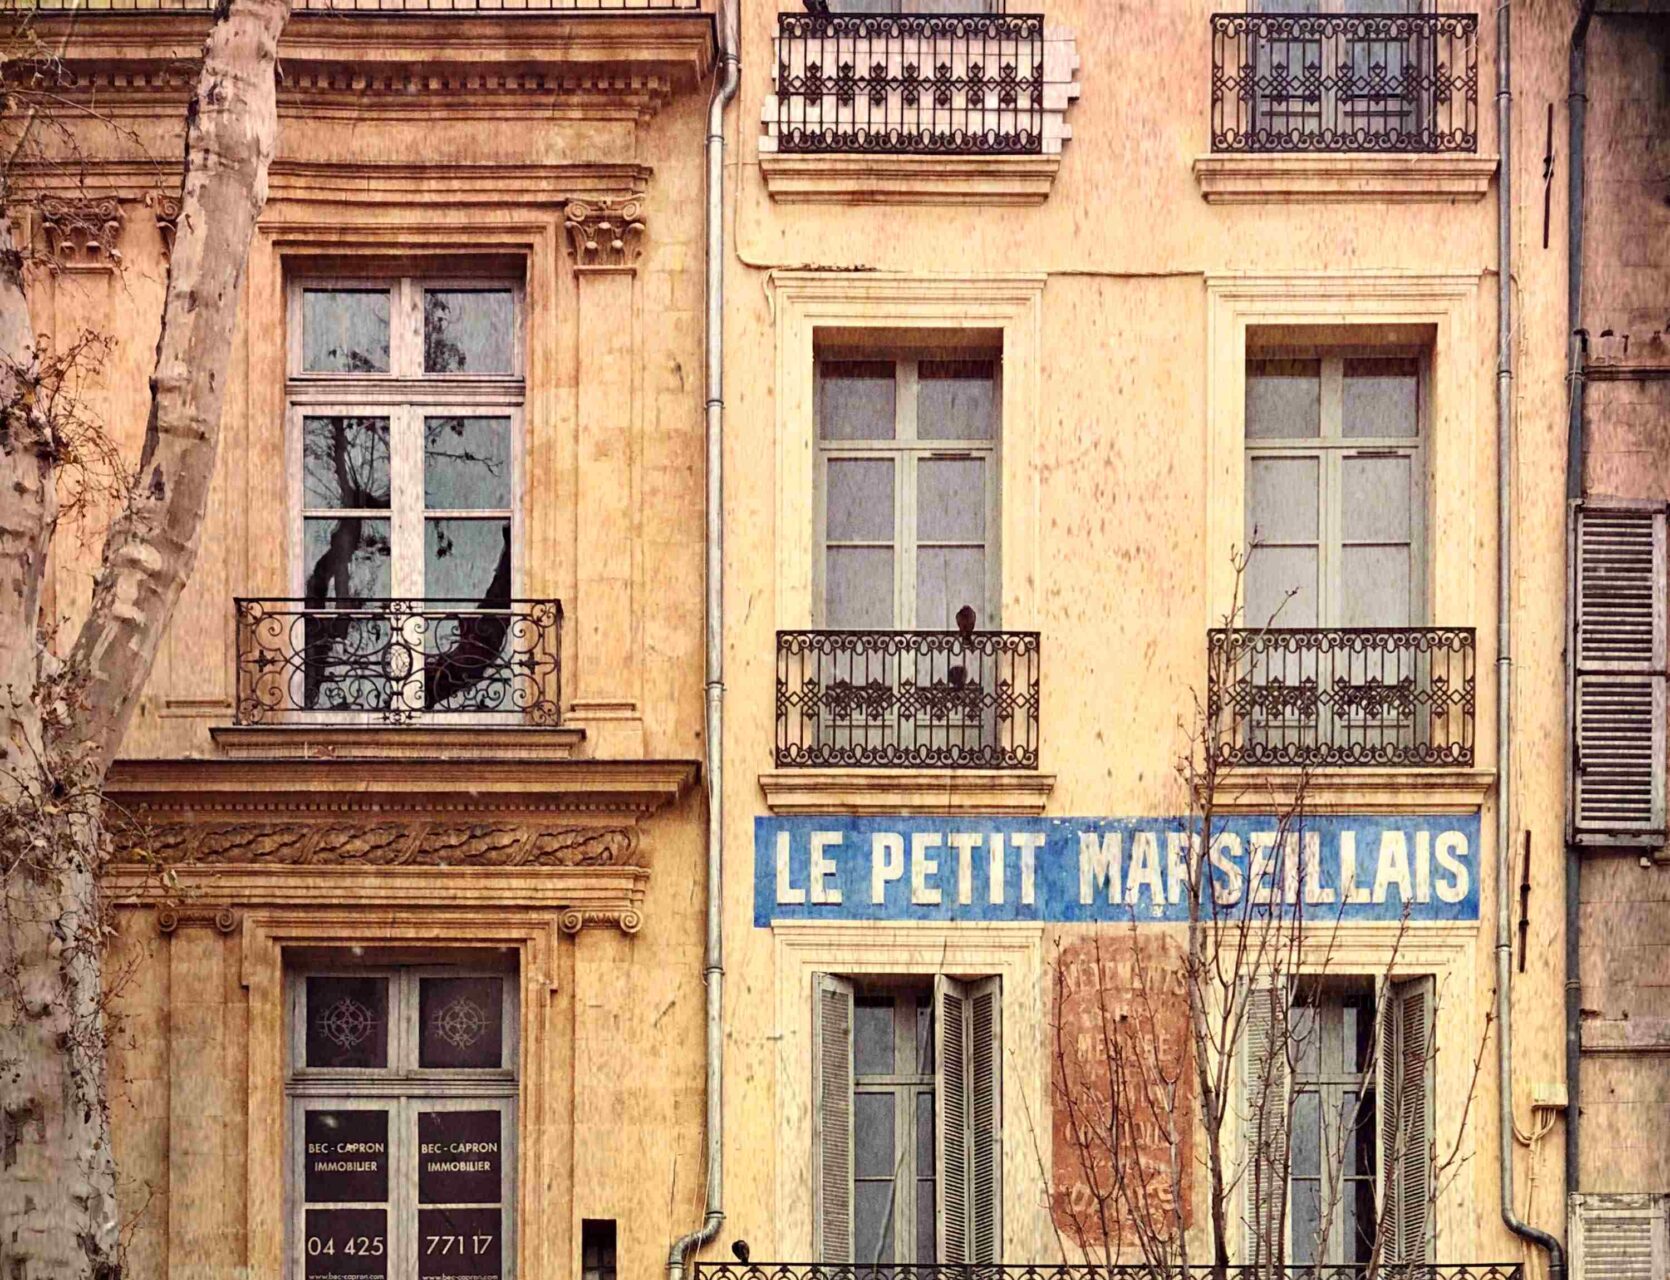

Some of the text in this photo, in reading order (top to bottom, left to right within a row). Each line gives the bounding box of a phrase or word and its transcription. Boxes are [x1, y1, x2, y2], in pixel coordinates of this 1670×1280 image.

[775, 831, 1469, 906] LE PETIT MARSEILLAIS
[308, 1143, 328, 1153] BEC
[337, 1143, 385, 1153] CAPRON
[421, 1143, 441, 1153] BEC
[450, 1143, 498, 1153] CAPRON
[314, 1161, 378, 1172] IMMOBILIER
[427, 1161, 491, 1172] IMMOBILIER
[307, 1236, 384, 1256] 04 425
[426, 1235, 493, 1255] 771 17
[308, 1271, 385, 1280] www.bec-capron.com
